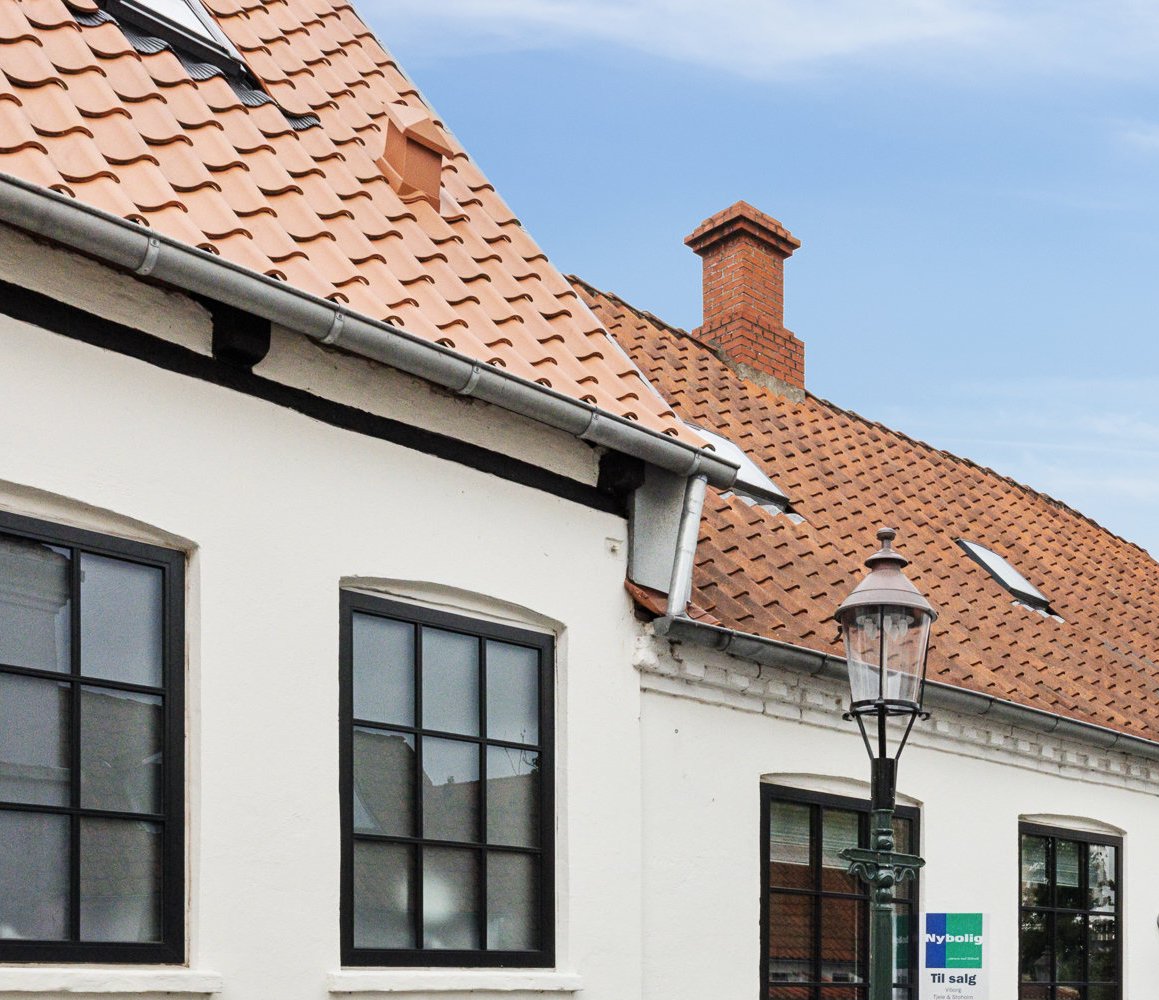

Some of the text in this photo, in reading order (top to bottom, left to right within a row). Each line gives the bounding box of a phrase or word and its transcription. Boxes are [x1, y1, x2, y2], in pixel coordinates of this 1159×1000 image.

[925, 933, 984, 946] Nybolig
[931, 973, 977, 986] Til salg
